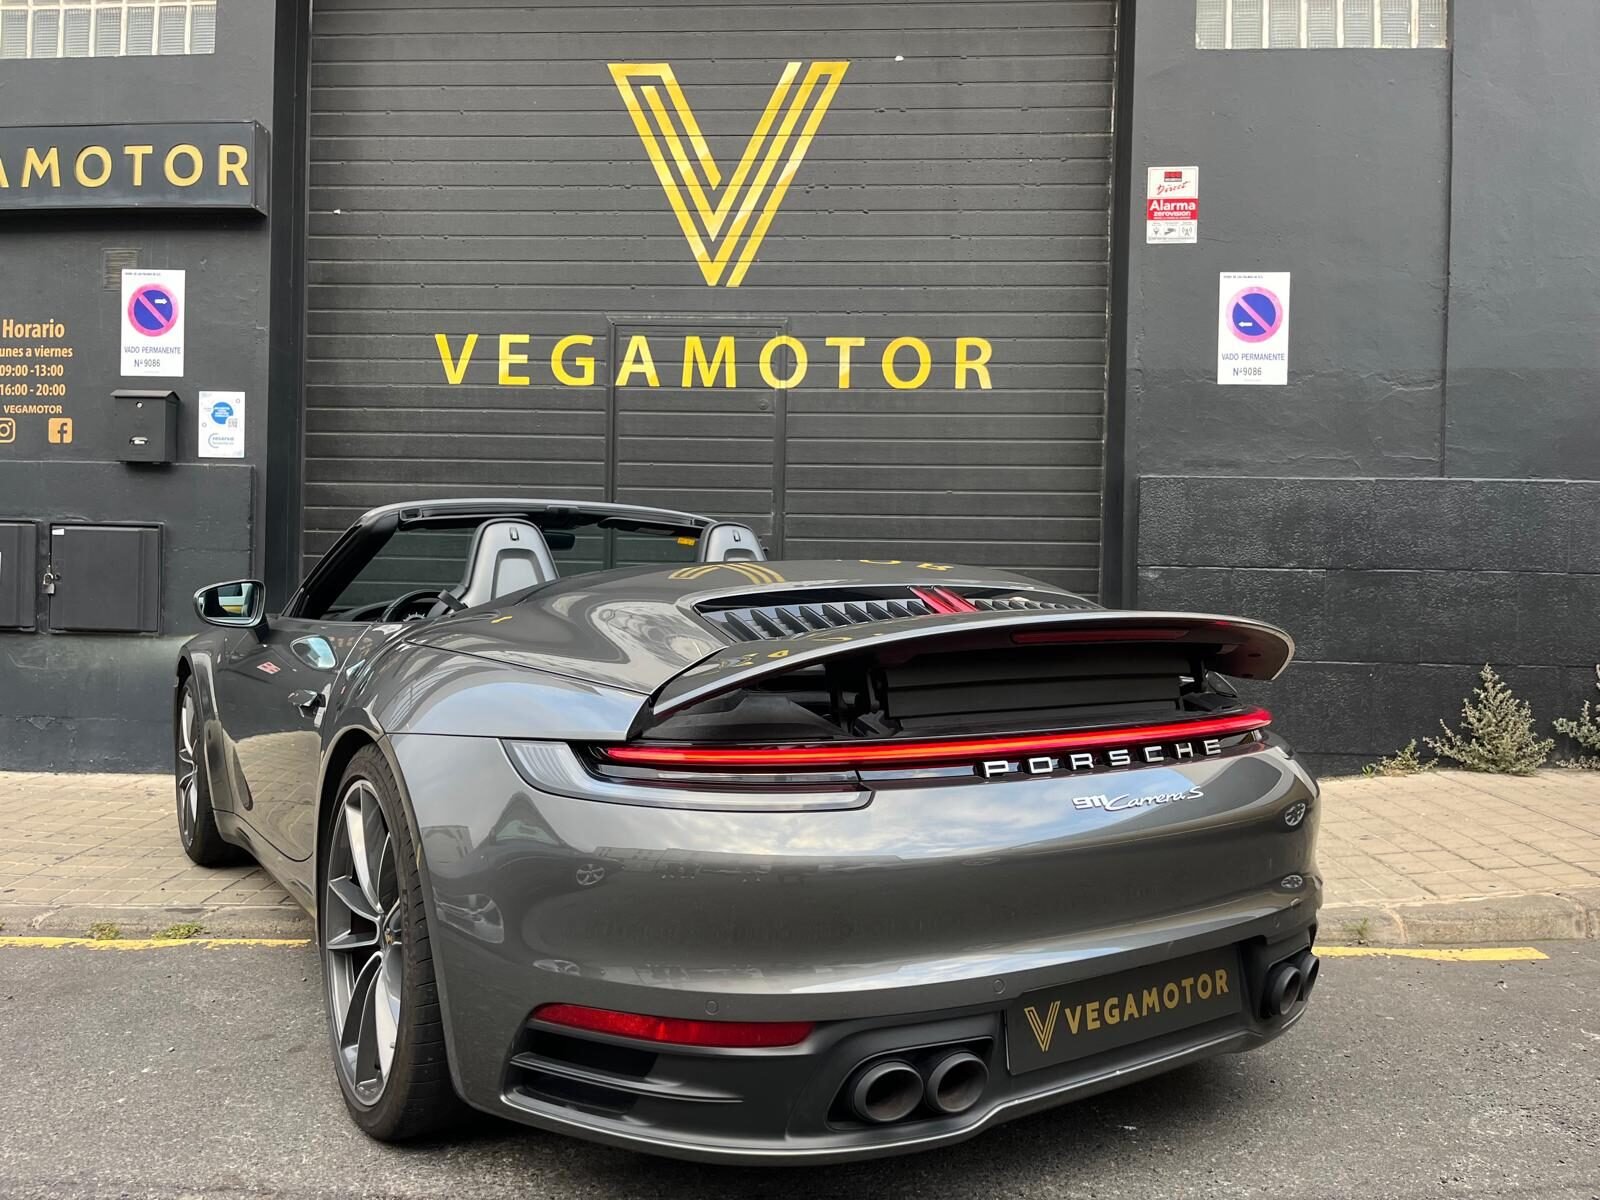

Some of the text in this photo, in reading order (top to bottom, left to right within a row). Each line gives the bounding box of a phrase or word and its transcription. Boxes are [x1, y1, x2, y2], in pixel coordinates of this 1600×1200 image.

[0, 143, 250, 189] MOTOR
[1149, 200, 1196, 211] Alarma
[2, 318, 65, 338] Horario
[25, 347, 32, 357] a
[34, 345, 73, 358] viernes
[124, 346, 181, 354] VADO PERMANENTE
[434, 333, 994, 390] VEGAMOTOR
[1221, 353, 1286, 361] VADO PERMANENTE
[0, 364, 28, 377] 09:00
[1242, 367, 1262, 376] 9086
[0, 383, 28, 396] 16:00
[35, 383, 66, 396] 20:00
[3, 404, 63, 414] VEGAMOTOR
[982, 739, 1222, 778] PORSCHE
[1072, 794, 1108, 810] 911
[1104, 792, 1186, 812] Carrera
[1064, 969, 1229, 1035] VEGAMOTOR
